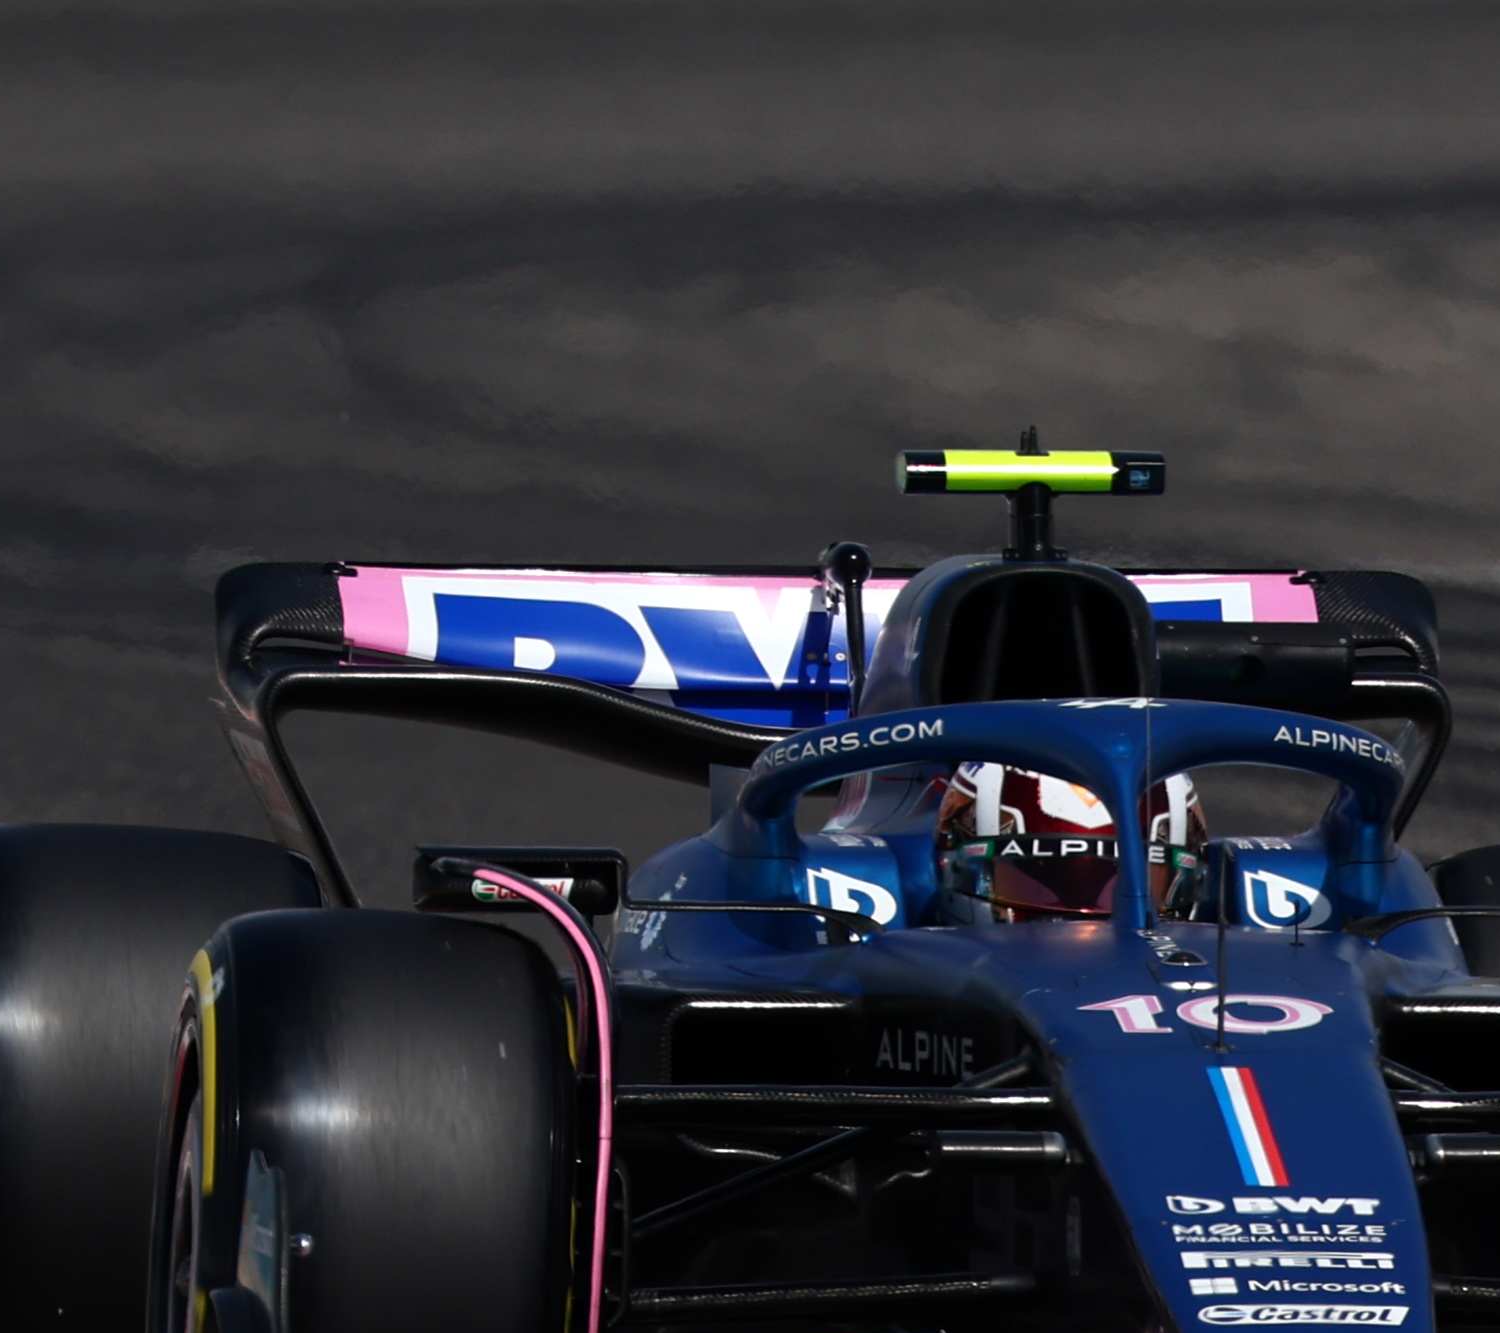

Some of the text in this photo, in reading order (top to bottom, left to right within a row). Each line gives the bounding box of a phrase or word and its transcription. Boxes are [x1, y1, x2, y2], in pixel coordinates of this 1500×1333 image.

[761, 718, 944, 769] NECARS.COM
[1000, 838, 1166, 864] ALPIE
[1078, 994, 1335, 1035] 10
[875, 1026, 975, 1080] ALPINE
[1231, 1196, 1381, 1216] BWT
[1174, 1236, 1384, 1244] FINANCIAL SERVICES
[1180, 1250, 1395, 1269] PIRELLI
[1247, 1280, 1407, 1294] Microsoft
[1249, 1306, 1394, 1323] Castrol
